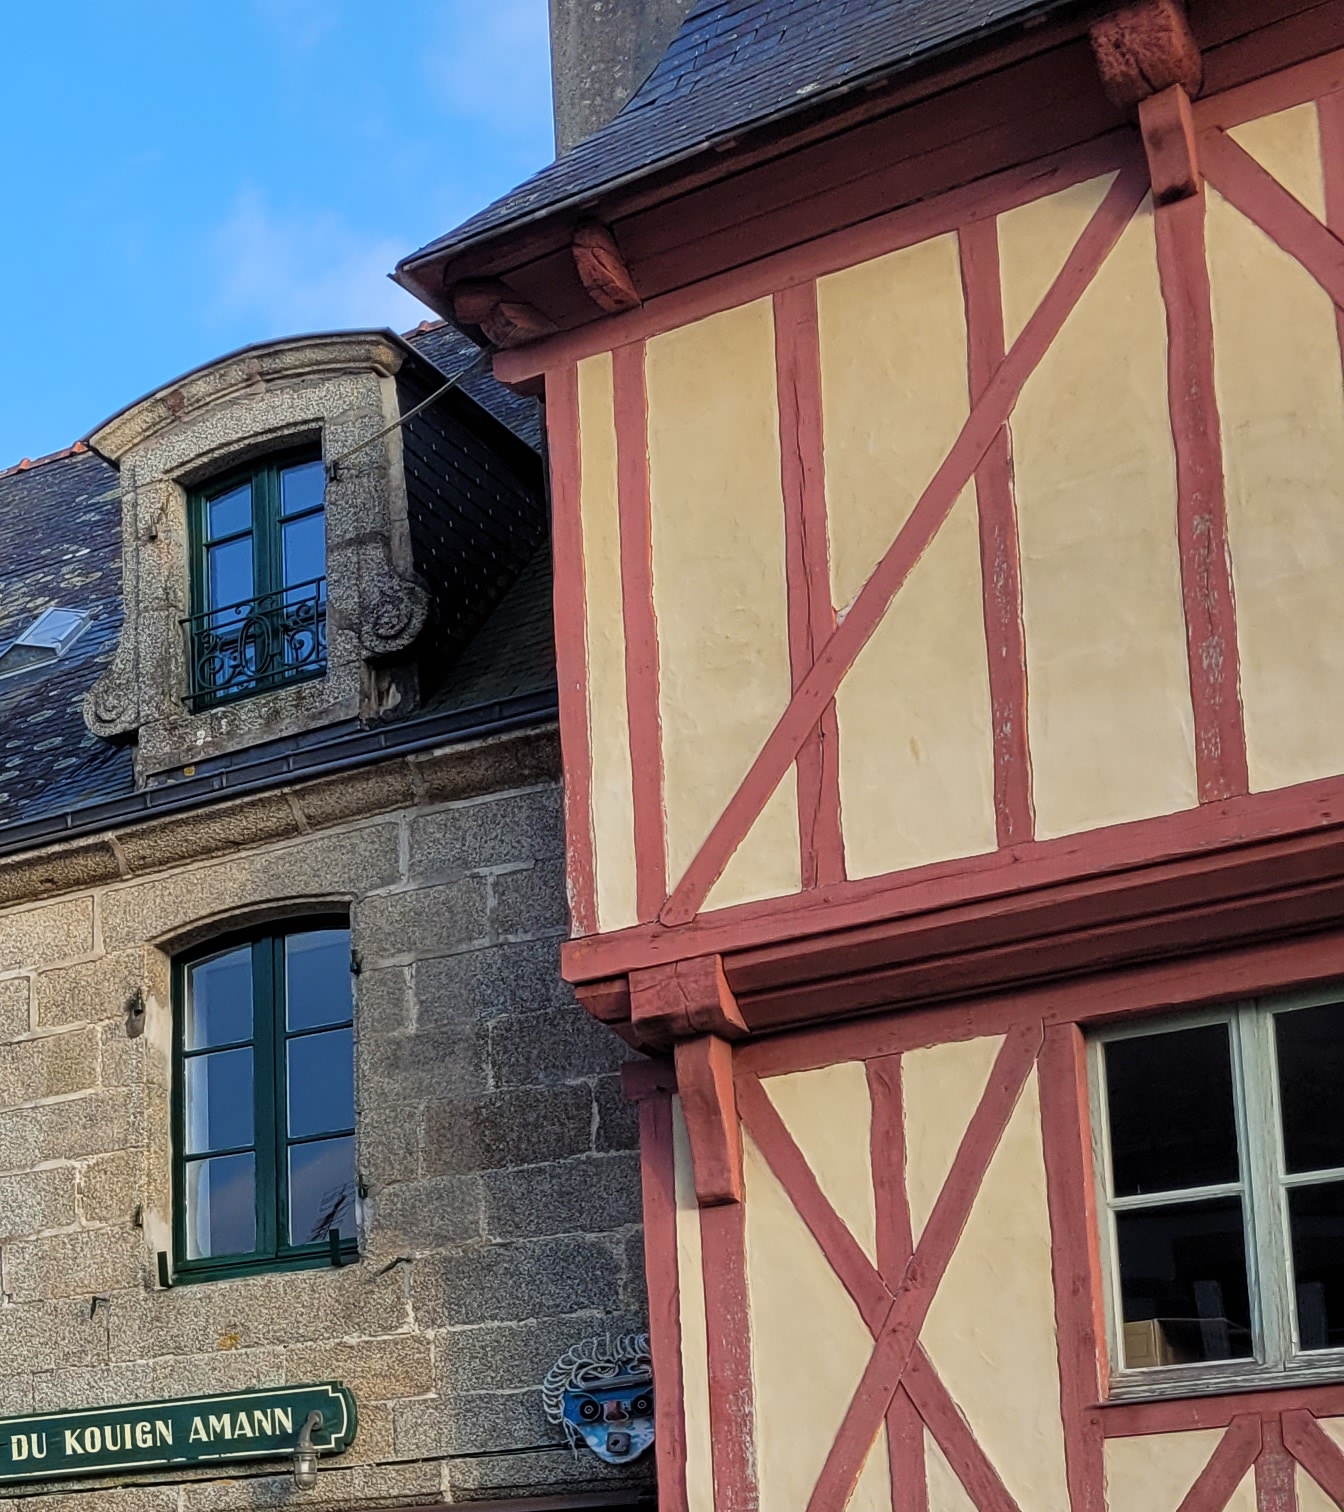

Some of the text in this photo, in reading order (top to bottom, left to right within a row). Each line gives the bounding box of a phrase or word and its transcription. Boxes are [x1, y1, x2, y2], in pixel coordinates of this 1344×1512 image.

[10, 1432, 47, 1461] DU
[64, 1419, 173, 1456] KOUIGN
[188, 1406, 293, 1444] AMANN
